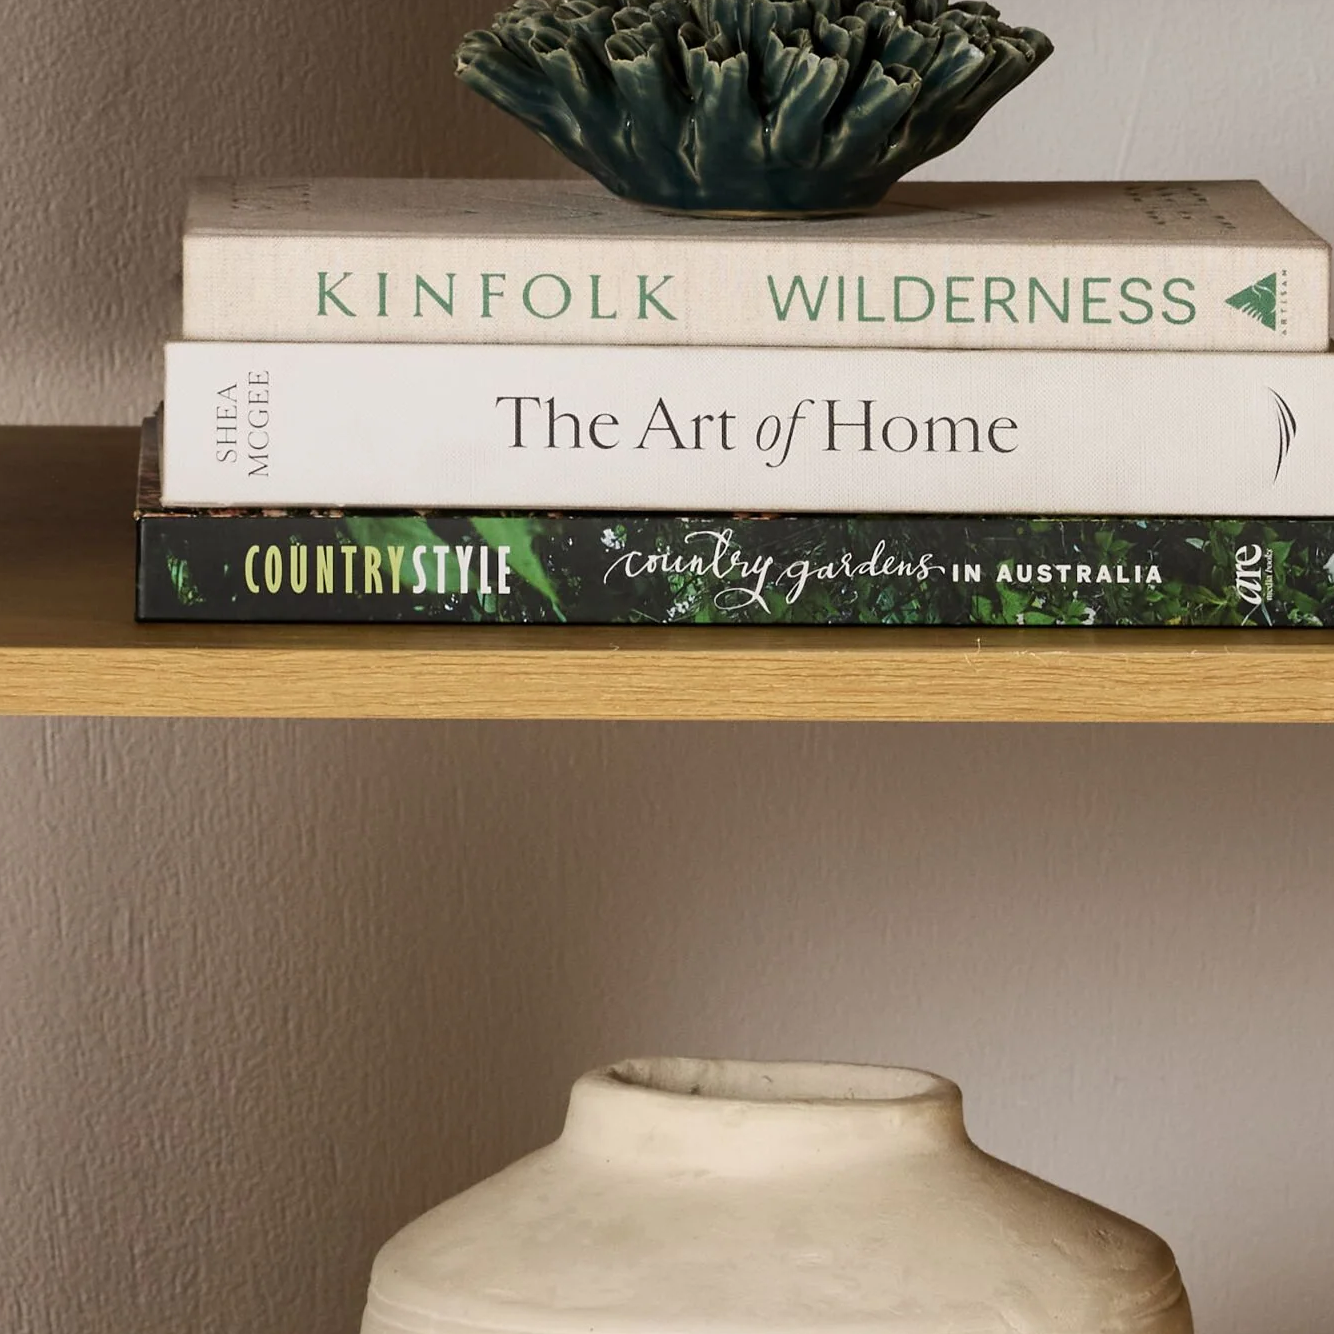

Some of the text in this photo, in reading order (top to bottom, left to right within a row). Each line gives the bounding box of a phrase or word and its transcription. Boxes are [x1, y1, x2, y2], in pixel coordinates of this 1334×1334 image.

[316, 271, 1197, 326] KINFOLK WILDERNESS
[1280, 269, 1288, 335] ARTISAN
[216, 383, 238, 463] SHEA
[247, 370, 269, 477] MCGEE
[495, 396, 1019, 468] The Art of Home
[244, 544, 511, 596] COUNTRYSTYLE
[603, 528, 1162, 615] country gardens IN AUSTRALIA
[1235, 543, 1262, 605] are
